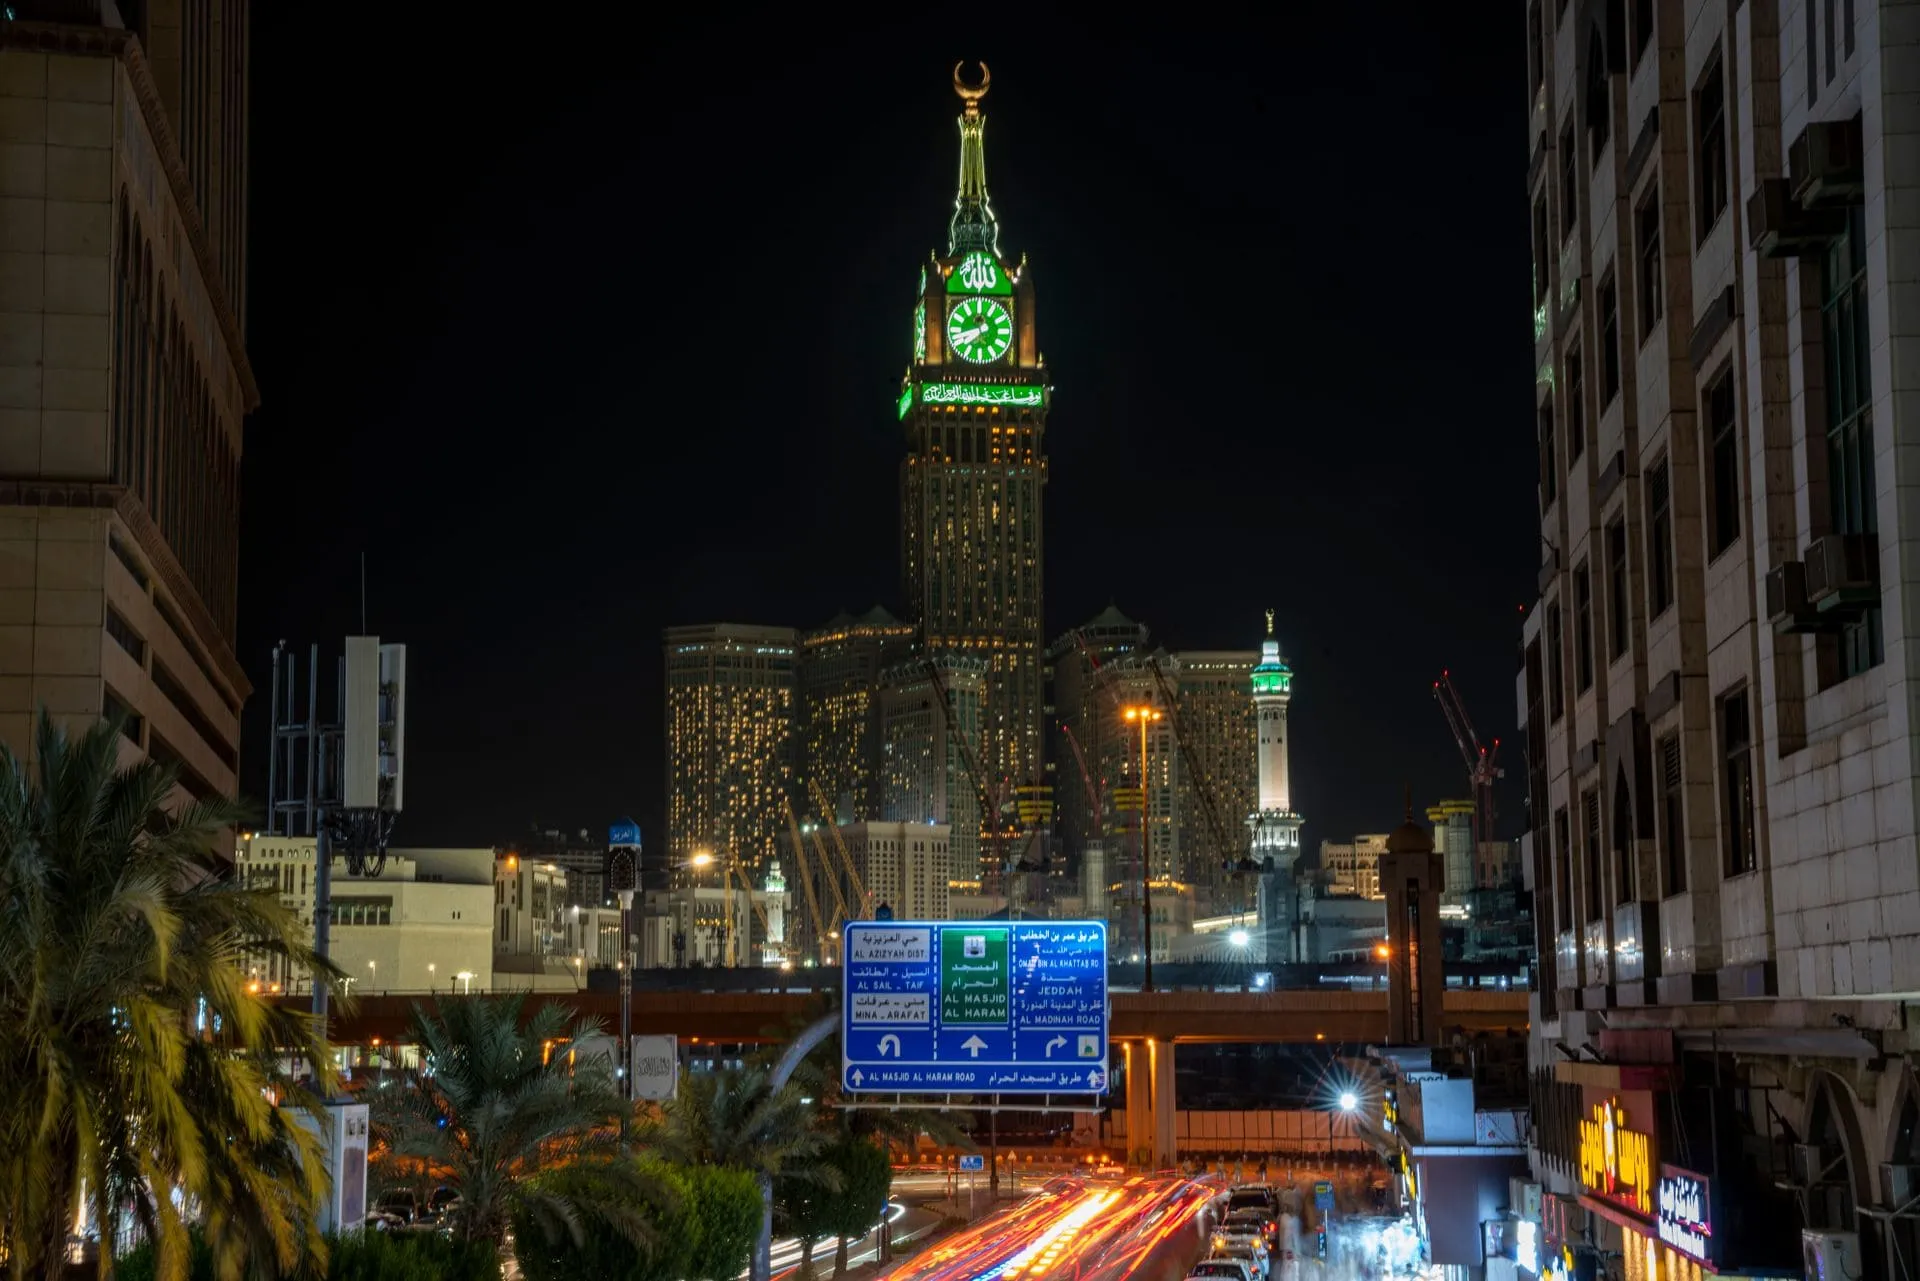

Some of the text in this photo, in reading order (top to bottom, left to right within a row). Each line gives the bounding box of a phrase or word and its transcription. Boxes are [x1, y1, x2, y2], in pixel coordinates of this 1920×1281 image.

[862, 932, 919, 947] حي العزيزية
[1020, 929, 1099, 943] طريق عمر بن الخطاب
[854, 949, 865, 958] AL
[868, 949, 905, 958] AZIZYAH
[951, 960, 998, 973] المسجد
[1037, 959, 1048, 969] BIN
[1049, 959, 1058, 969] AL
[1059, 959, 1089, 969] KHATTAB
[851, 966, 889, 977] الطائف
[901, 967, 930, 979] السيل
[1040, 972, 1078, 984] جدة
[857, 981, 869, 990] AL
[873, 981, 893, 990] SAIL
[905, 981, 924, 990] TAIF
[951, 977, 998, 992] الحرام
[1038, 986, 1082, 996] JEDDAH
[856, 996, 889, 1007] عرفات
[944, 994, 1006, 1004] AL MASJID
[1021, 999, 1101, 1012] طريق المدينة المنورة
[855, 1011, 878, 1020] MINA
[886, 1010, 926, 1020] ARAFAT
[944, 1008, 1006, 1018] AL HARAM
[1020, 1015, 1101, 1024] AL MADINAH ROAD
[869, 1072, 975, 1081] AL MASJID AL HARAM ROAD
[988, 1072, 1082, 1086] طريق المسجد الحرام
